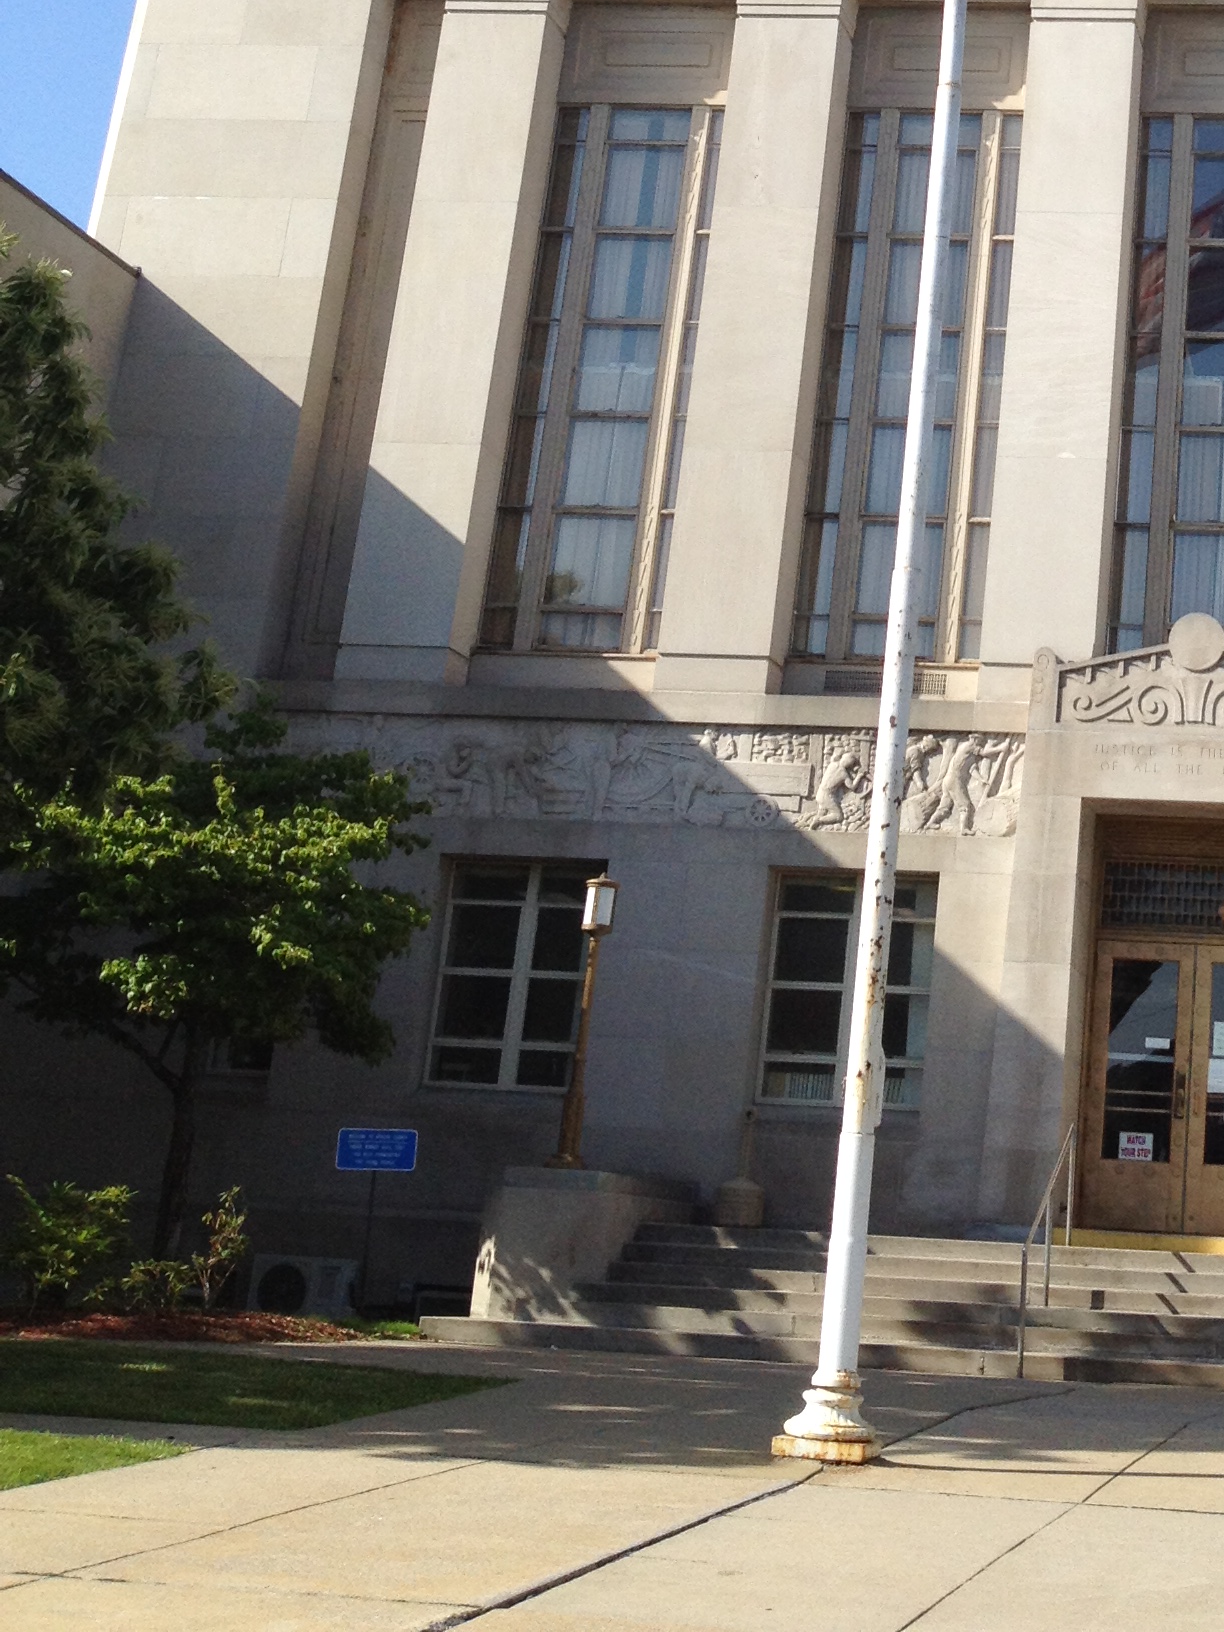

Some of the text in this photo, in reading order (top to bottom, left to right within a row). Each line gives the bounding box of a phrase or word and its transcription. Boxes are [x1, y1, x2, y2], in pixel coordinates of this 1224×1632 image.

[1095, 744, 1157, 756] JUSTICE
[1200, 747, 1224, 759] THE
[1100, 761, 1119, 771] OF
[1133, 762, 1159, 773] ALL
[1176, 764, 1203, 775] THE
